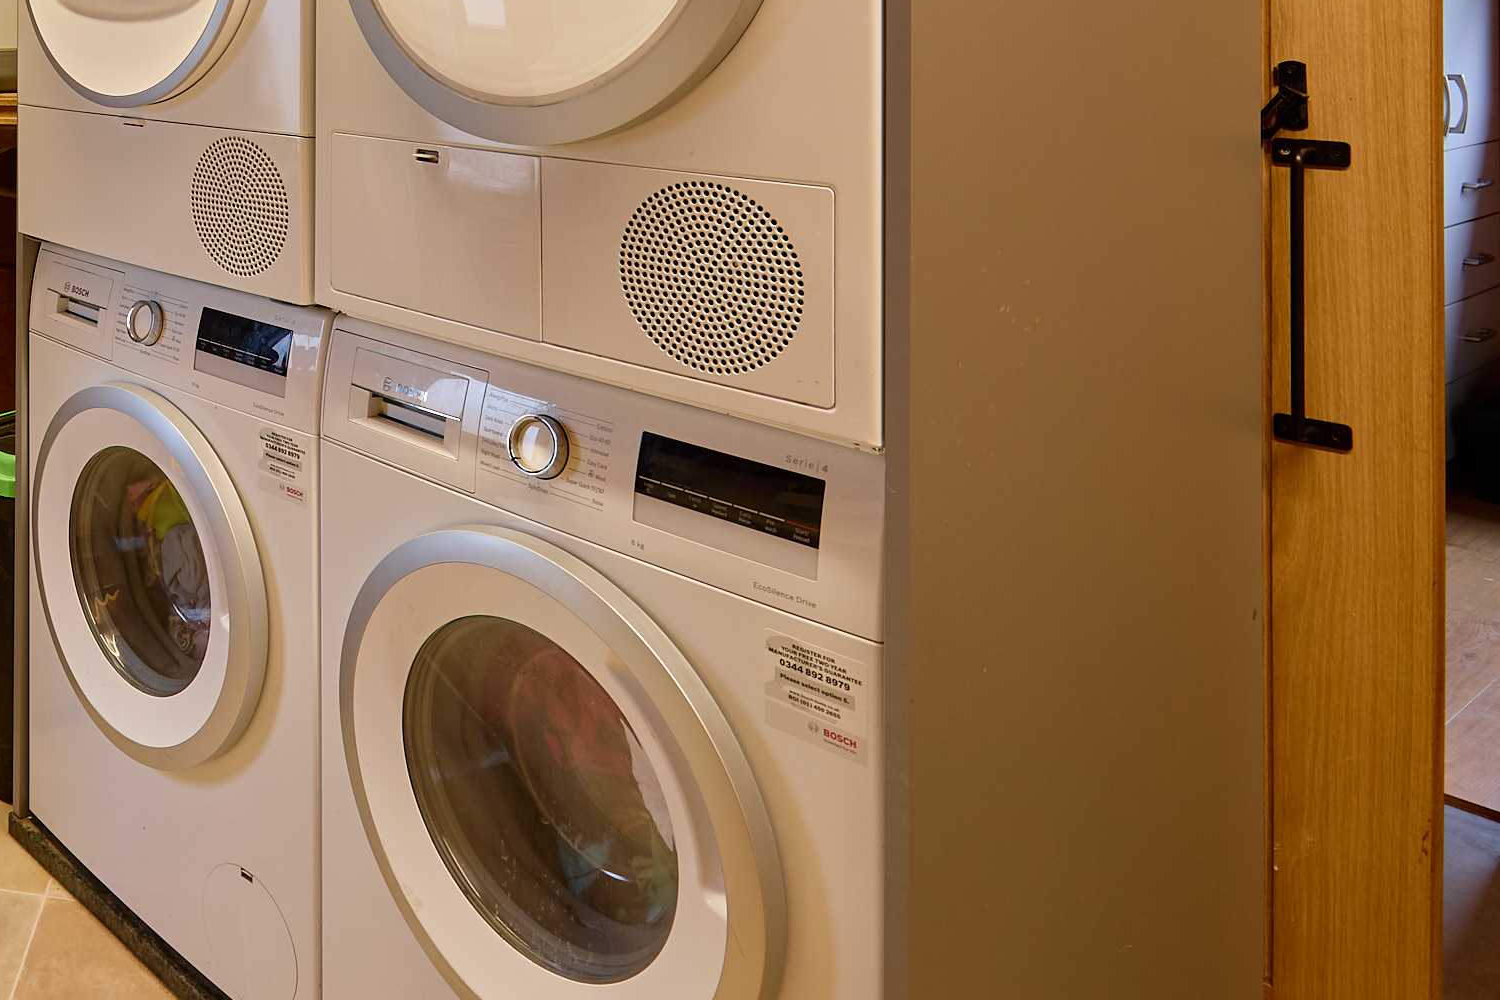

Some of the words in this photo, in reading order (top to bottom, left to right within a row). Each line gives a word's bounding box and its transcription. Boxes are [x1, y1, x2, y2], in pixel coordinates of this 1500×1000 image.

[71, 285, 90, 297] BOSCH
[395, 382, 428, 402] BOSCH
[253, 402, 273, 413] EcoSilence
[597, 424, 613, 433] Cottons
[598, 437, 611, 446] 40-60
[265, 443, 277, 452] 0344
[278, 447, 287, 455] 892
[288, 451, 300, 459] 8979
[490, 451, 500, 459] Wash
[590, 448, 609, 458] Intensive
[480, 460, 490, 468] Mixed
[491, 463, 500, 471] Load
[587, 459, 597, 467] Easy
[597, 462, 607, 470] Care
[785, 454, 815, 470] Serie
[822, 465, 829, 473] 4
[566, 477, 578, 485] Super
[578, 481, 590, 490] Quick
[595, 474, 606, 482] Wool
[287, 487, 303, 497] BOSCH
[528, 482, 549, 494] Spin/Drain
[793, 533, 810, 544] Reload
[753, 582, 794, 602] EcoSilence
[796, 596, 817, 609] Drive
[792, 644, 821, 659] REGISTER
[781, 646, 798, 656] YOUR
[799, 652, 814, 662] FREE
[815, 659, 830, 668] TWO
[830, 663, 847, 674] YEAR
[768, 647, 823, 671] MANUFACTURER'S
[824, 668, 862, 686] GUARANTEE
[779, 659, 803, 673] 0344
[805, 668, 824, 681] 892
[825, 676, 850, 691] 8979
[780, 673, 800, 684] Please
[801, 680, 820, 693] select
[821, 689, 842, 701] option
[788, 694, 799, 703] ROI
[800, 698, 813, 708] (01)
[813, 704, 824, 713] 450
[825, 708, 841, 719] 2655
[823, 728, 857, 748] BOSCH
